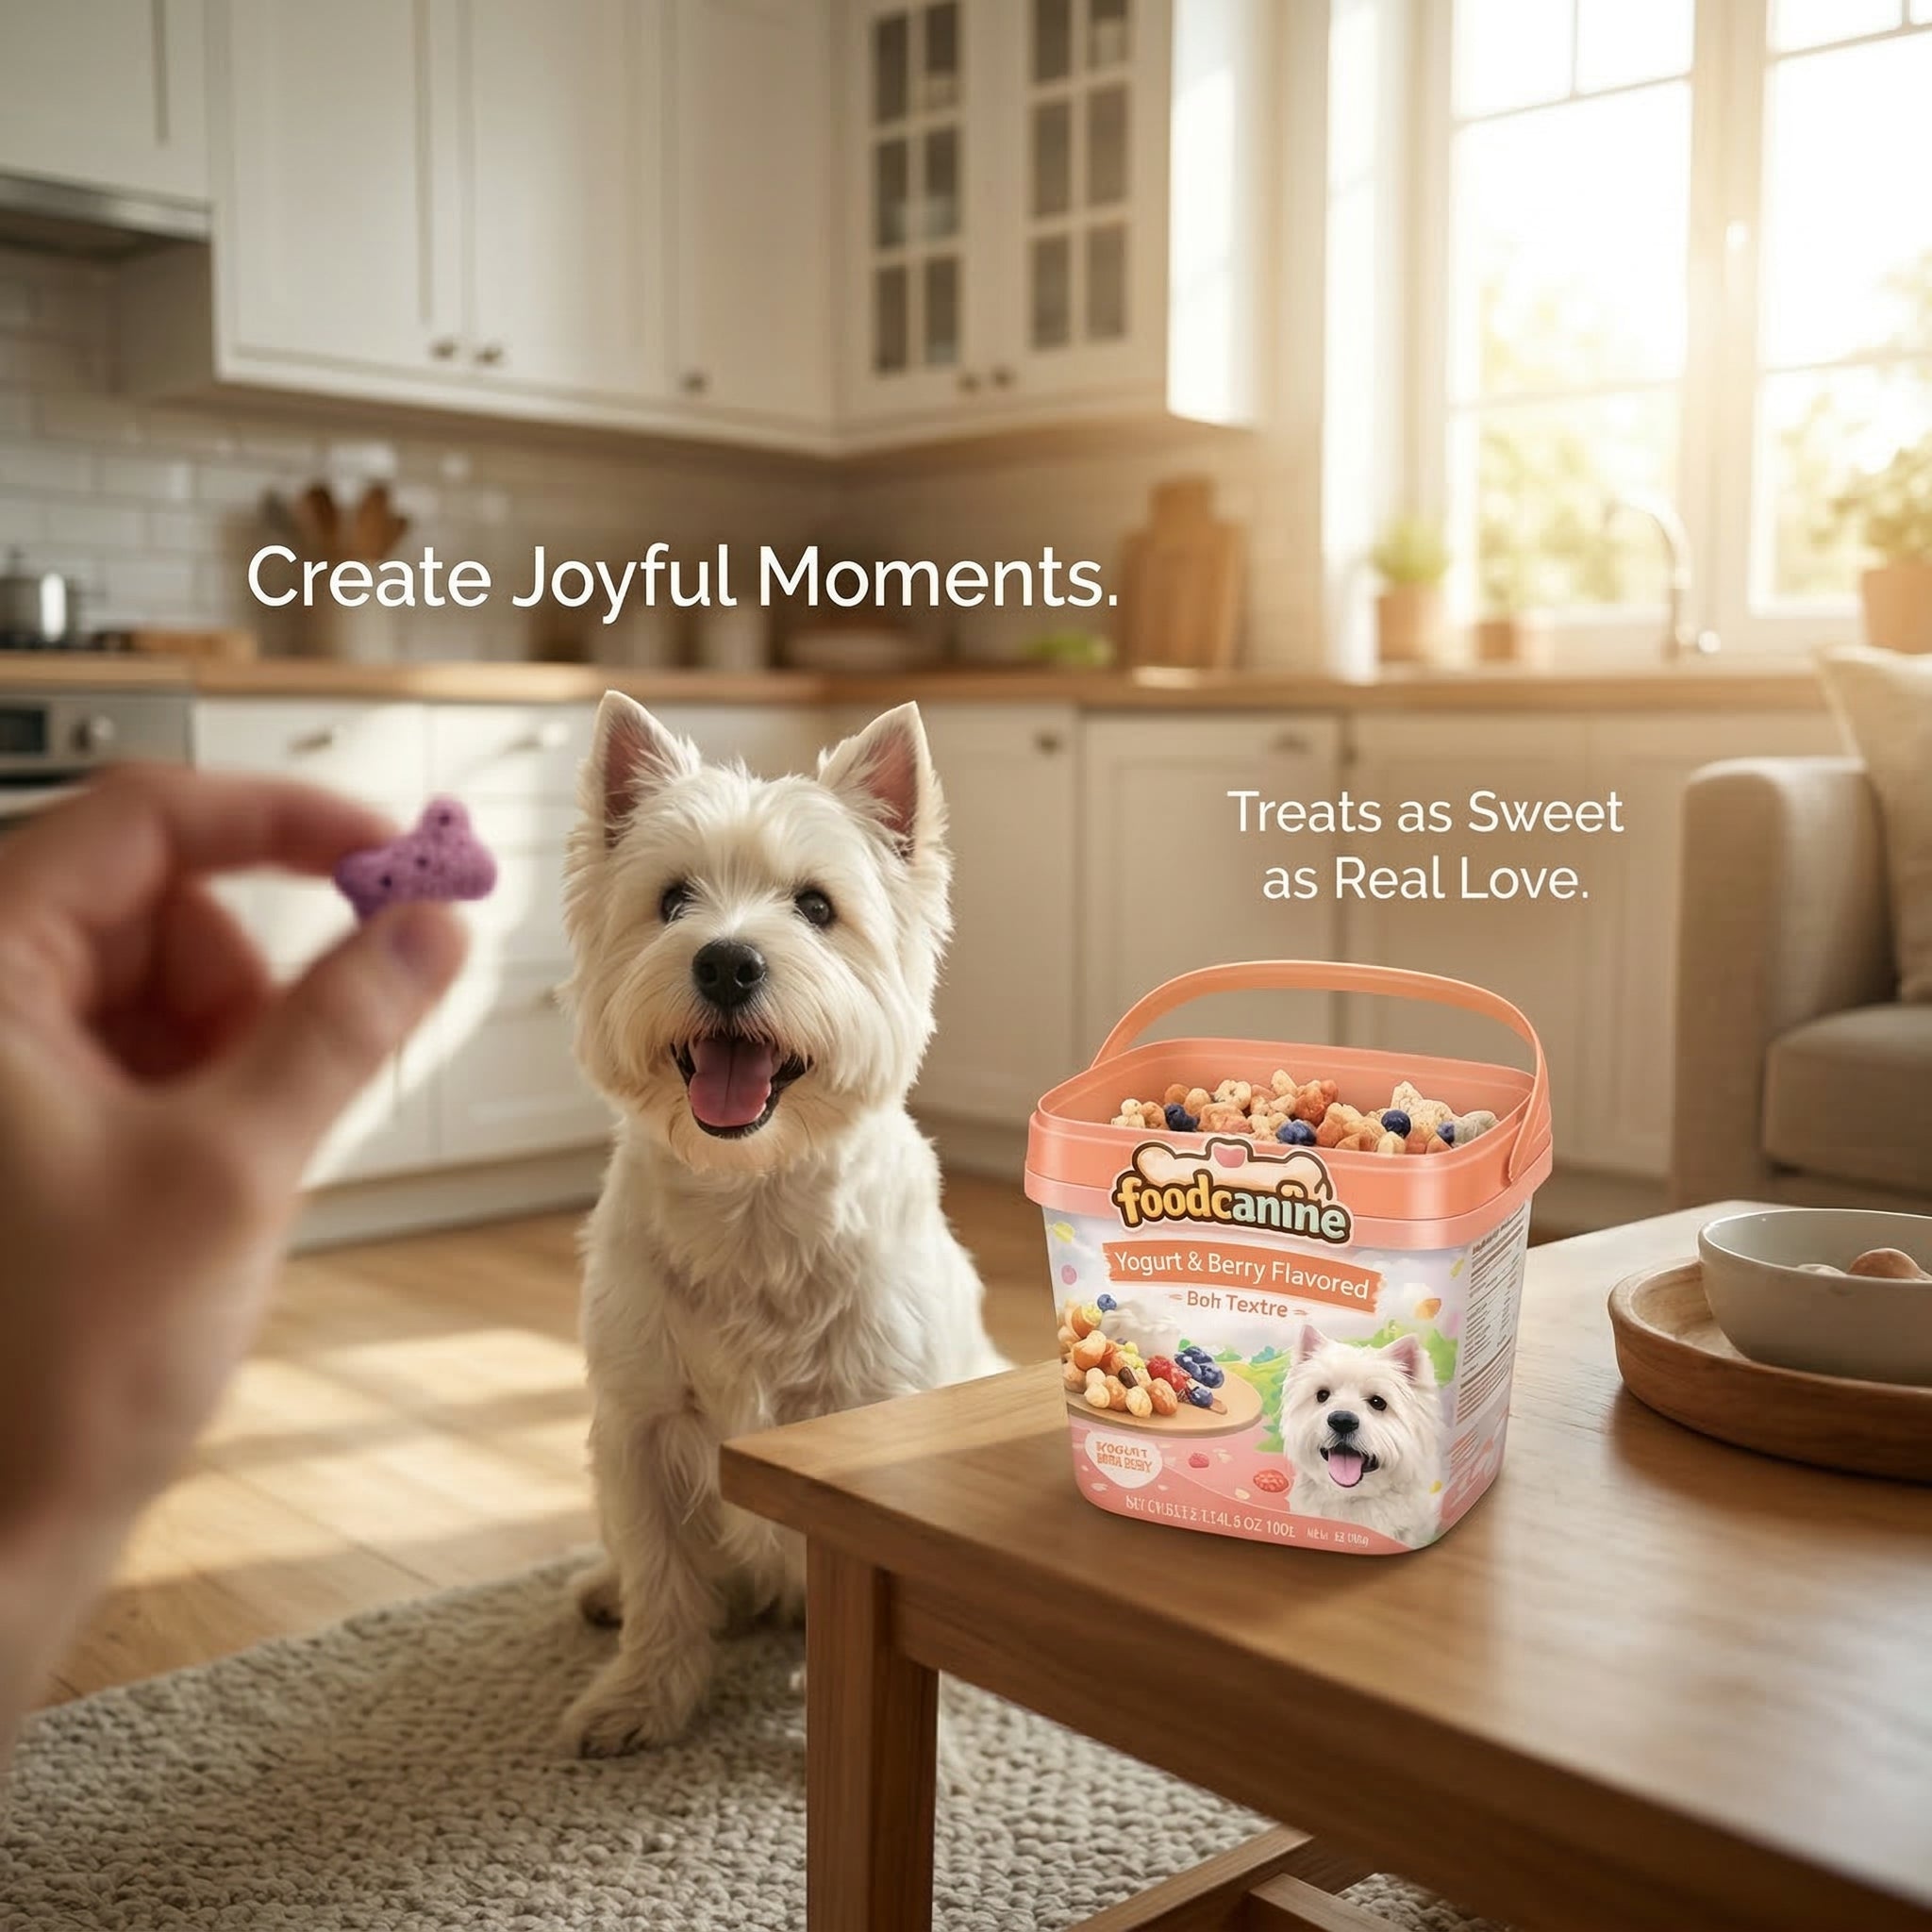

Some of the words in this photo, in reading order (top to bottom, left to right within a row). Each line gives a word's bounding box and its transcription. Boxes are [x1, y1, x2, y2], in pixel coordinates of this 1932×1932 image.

[1115, 1171, 1349, 1242] foodcanine
[1114, 1252, 1183, 1276] Yogurt
[1187, 1252, 1203, 1272] &
[1208, 1253, 1266, 1284] Berry
[1272, 1261, 1371, 1300] Flavored
[1225, 1294, 1289, 1318] Textre
